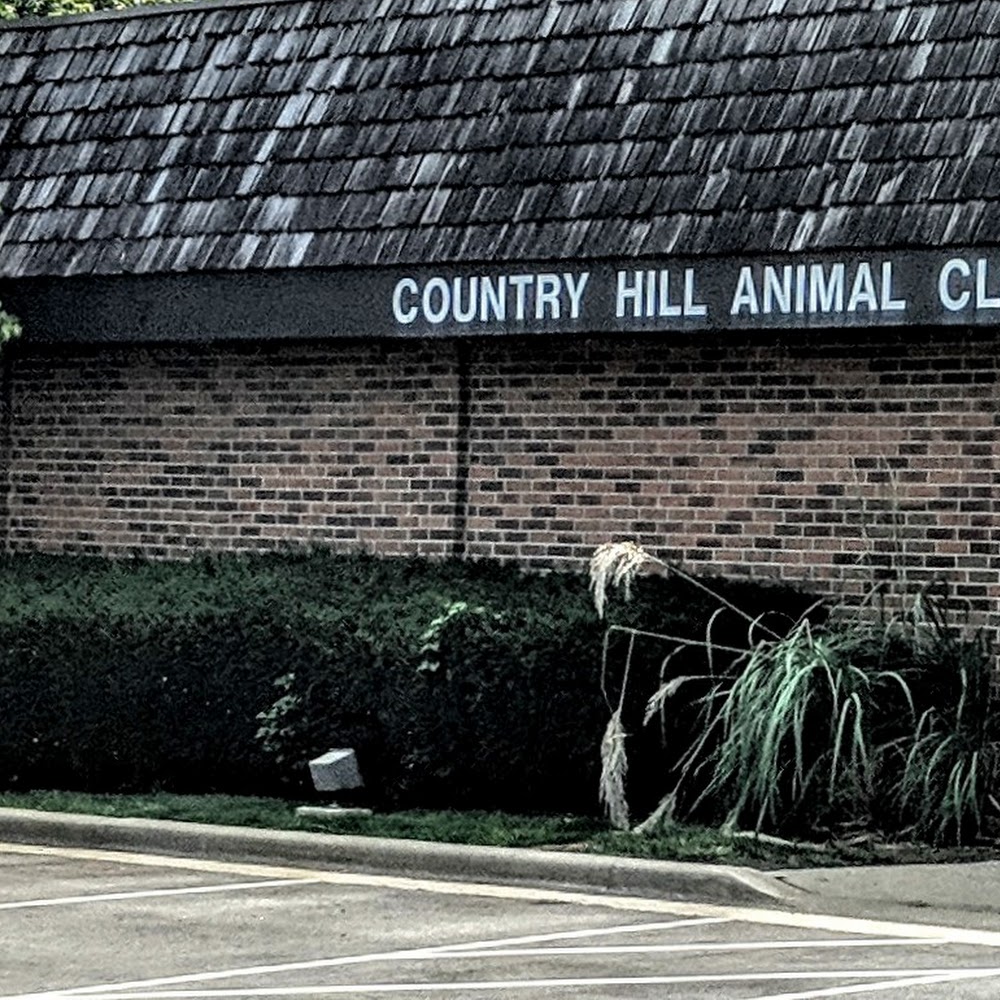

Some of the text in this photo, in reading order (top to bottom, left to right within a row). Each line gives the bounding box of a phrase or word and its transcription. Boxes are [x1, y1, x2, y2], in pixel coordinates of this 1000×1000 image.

[392, 271, 590, 324] COUNTRY
[615, 267, 708, 318] HILL
[730, 261, 906, 315] ANIMAL
